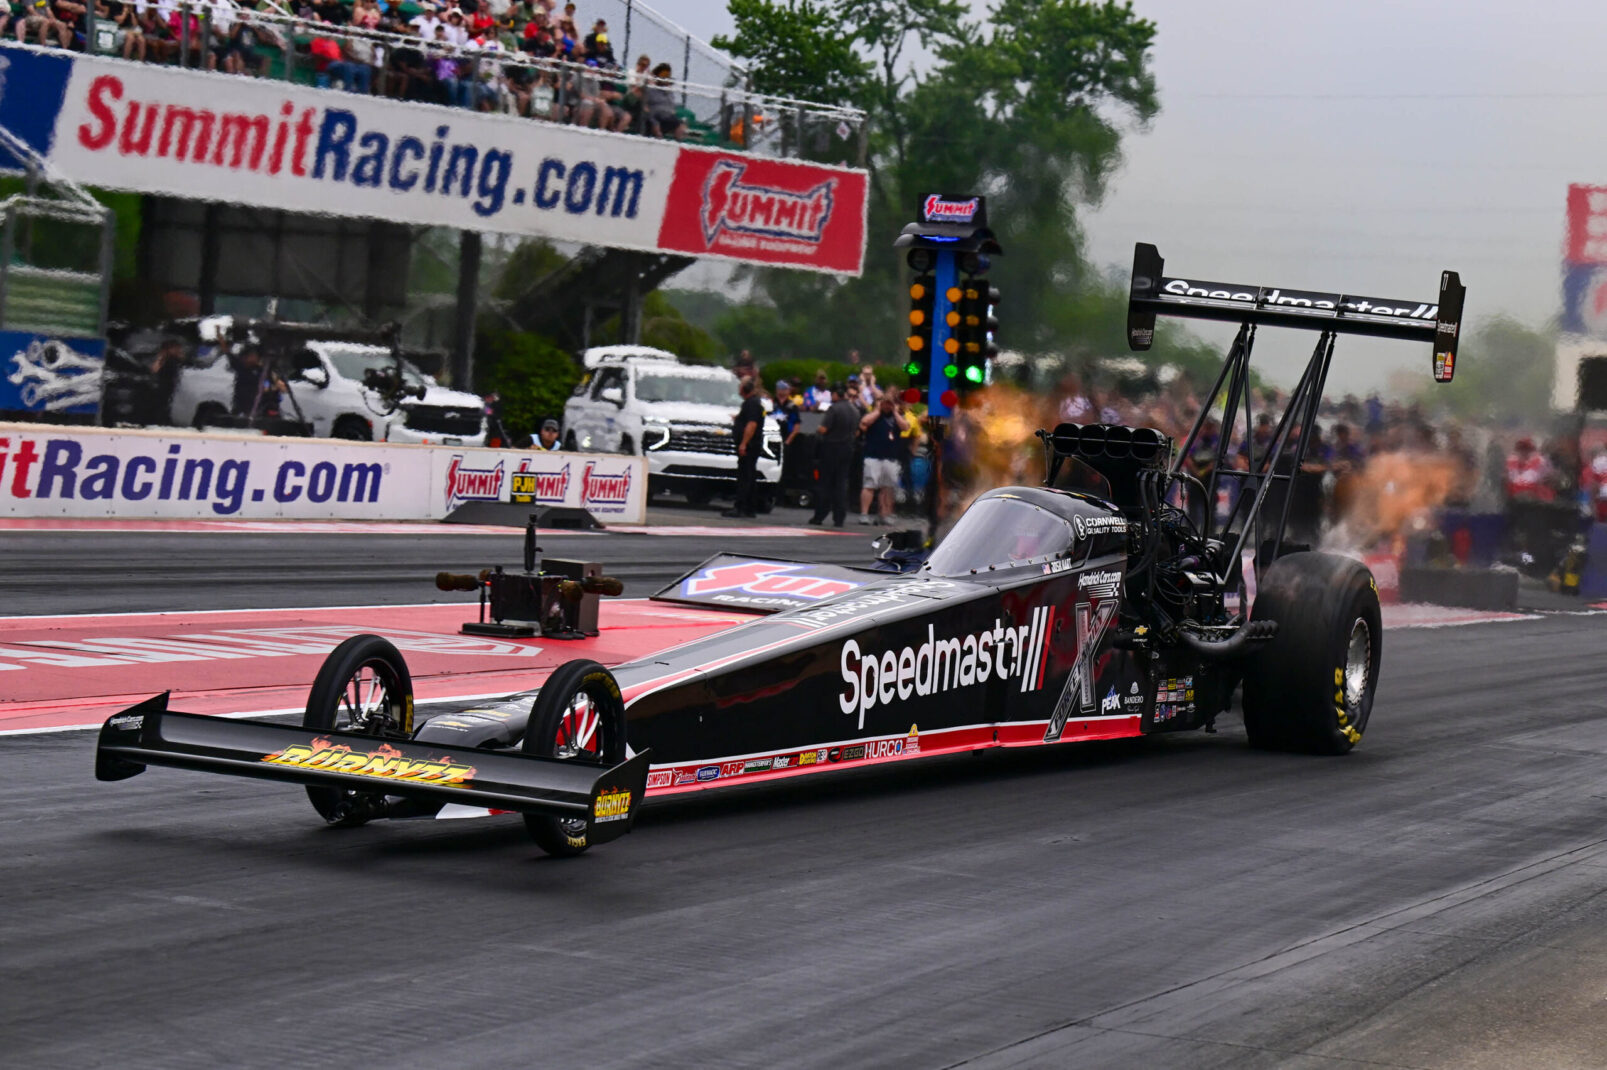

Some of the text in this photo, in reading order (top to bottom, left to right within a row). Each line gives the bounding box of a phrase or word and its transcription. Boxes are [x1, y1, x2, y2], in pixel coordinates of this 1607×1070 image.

[77, 75, 645, 218] SummitRacing.com
[707, 165, 826, 233] SUMMIT
[926, 195, 976, 217] SUMMIT
[446, 457, 503, 500] SUMMIT
[512, 475, 535, 493] PJH
[581, 463, 629, 502] SUMMIT
[1085, 517, 1126, 527] CORNWELL
[1086, 525, 1127, 534] QUALITY TOOLS
[1101, 693, 1120, 715] PEAK
[1124, 696, 1144, 705] BANDERO
[864, 739, 903, 760] HURCO
[647, 771, 672, 787] SIMPSON
[720, 761, 744, 777] ARP
[594, 792, 631, 818] BURNYZZ
